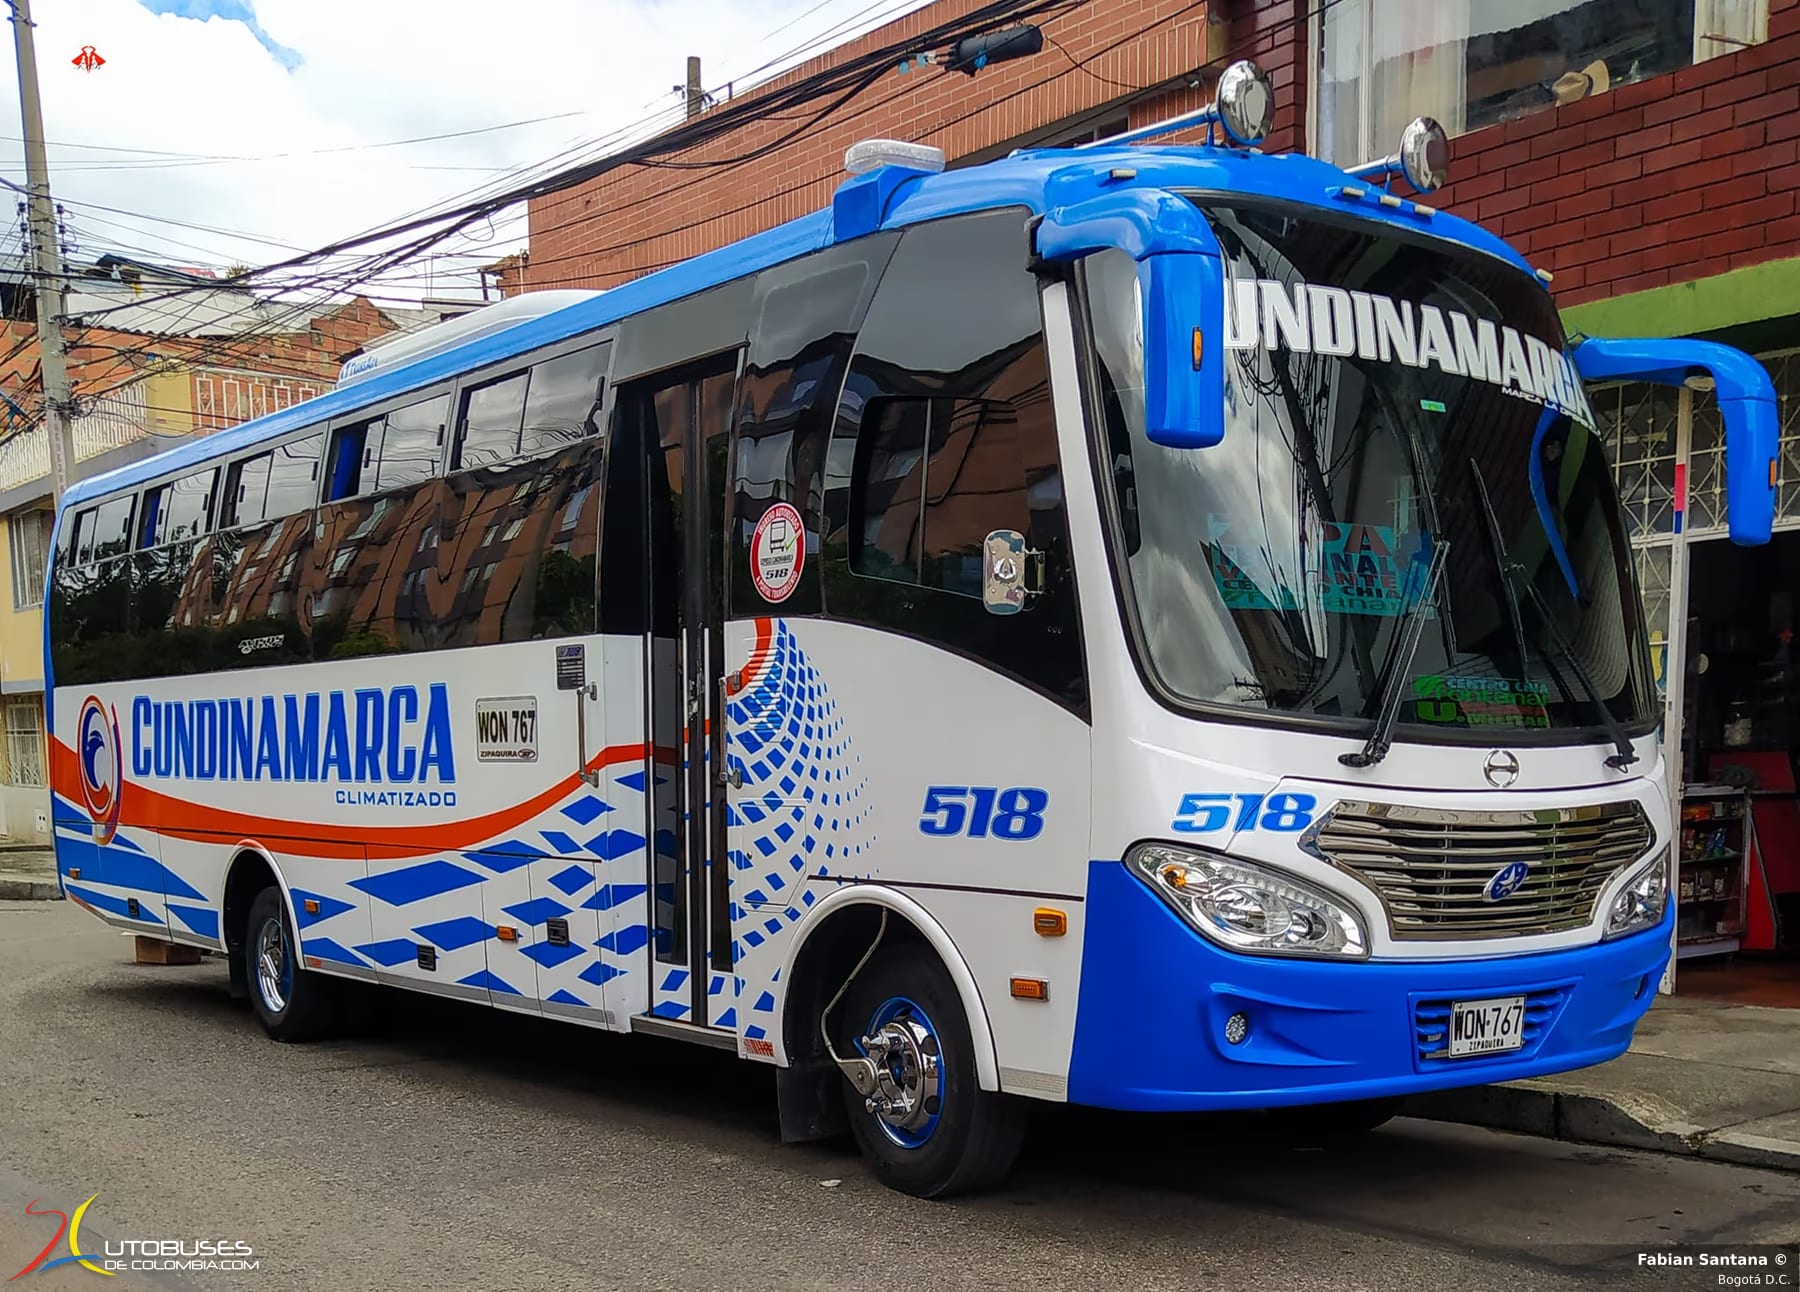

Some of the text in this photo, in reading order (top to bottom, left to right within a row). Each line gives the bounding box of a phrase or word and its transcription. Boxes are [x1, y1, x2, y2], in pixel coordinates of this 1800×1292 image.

[1136, 277, 1600, 435] UNDINAMARCA
[765, 568, 789, 580] 518
[131, 681, 457, 784] CUNDINAMARCA
[478, 710, 536, 744] WON 767
[480, 750, 518, 759] ZIPAQUIRA
[335, 790, 457, 807] CLIMATIZADO
[918, 785, 1050, 840] 518
[1171, 791, 1318, 833] 518
[1468, 1038, 1505, 1051] ZIPAQUIRA
